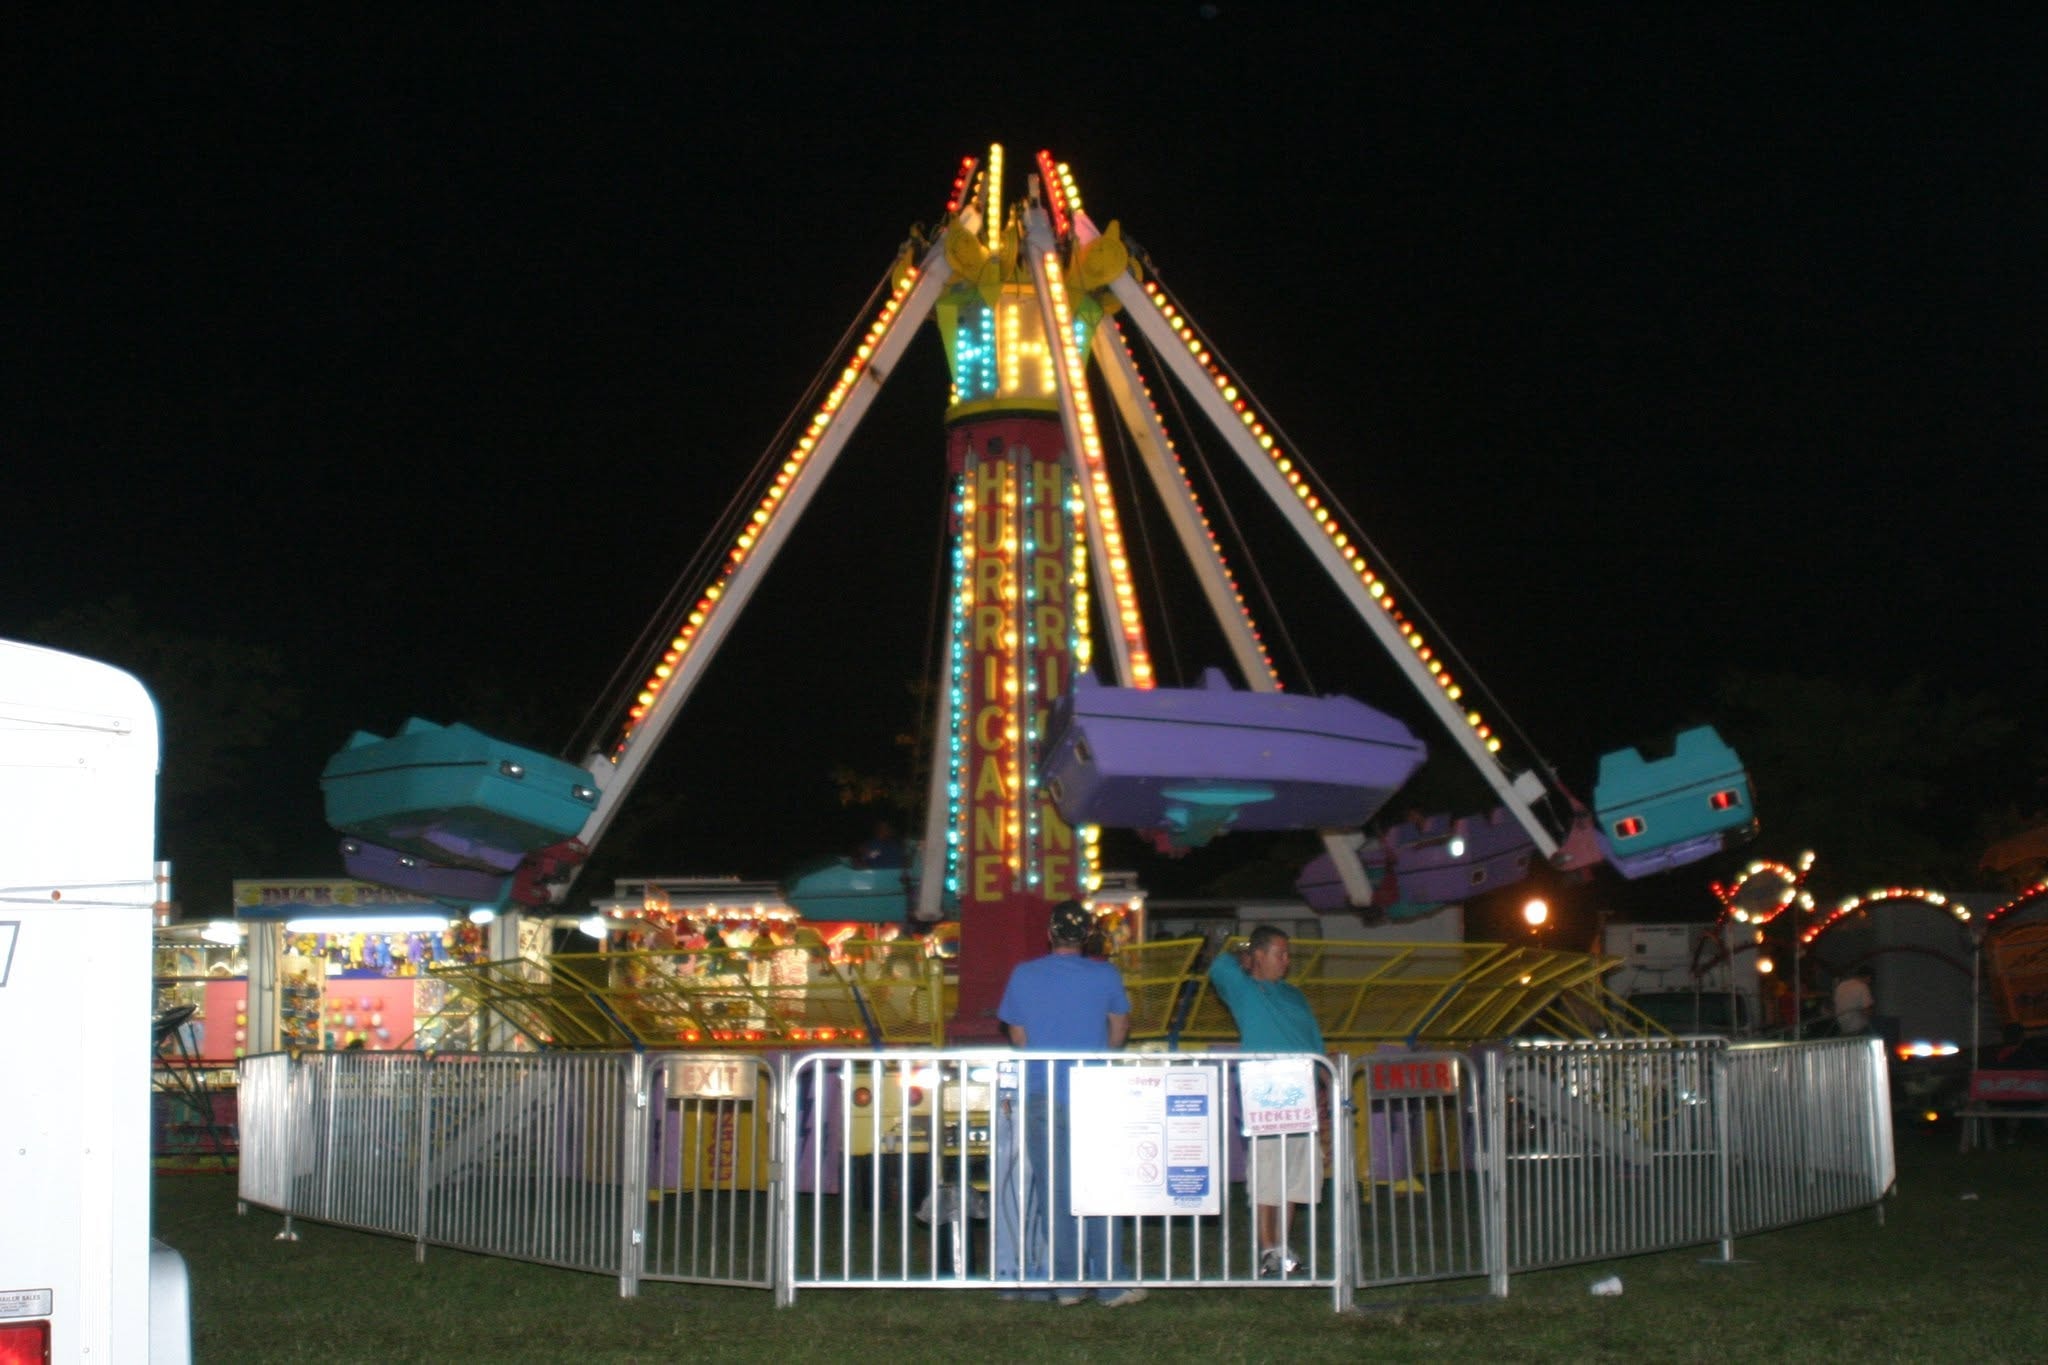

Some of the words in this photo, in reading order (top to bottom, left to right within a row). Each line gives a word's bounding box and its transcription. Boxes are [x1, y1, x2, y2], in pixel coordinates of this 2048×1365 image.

[975, 461, 1007, 901] HURRICANE
[1034, 461, 1071, 901] HURRINE
[682, 1065, 738, 1092] EXIT
[1373, 1061, 1451, 1093] ENTER
[1248, 1108, 1312, 1123] TICKETS
